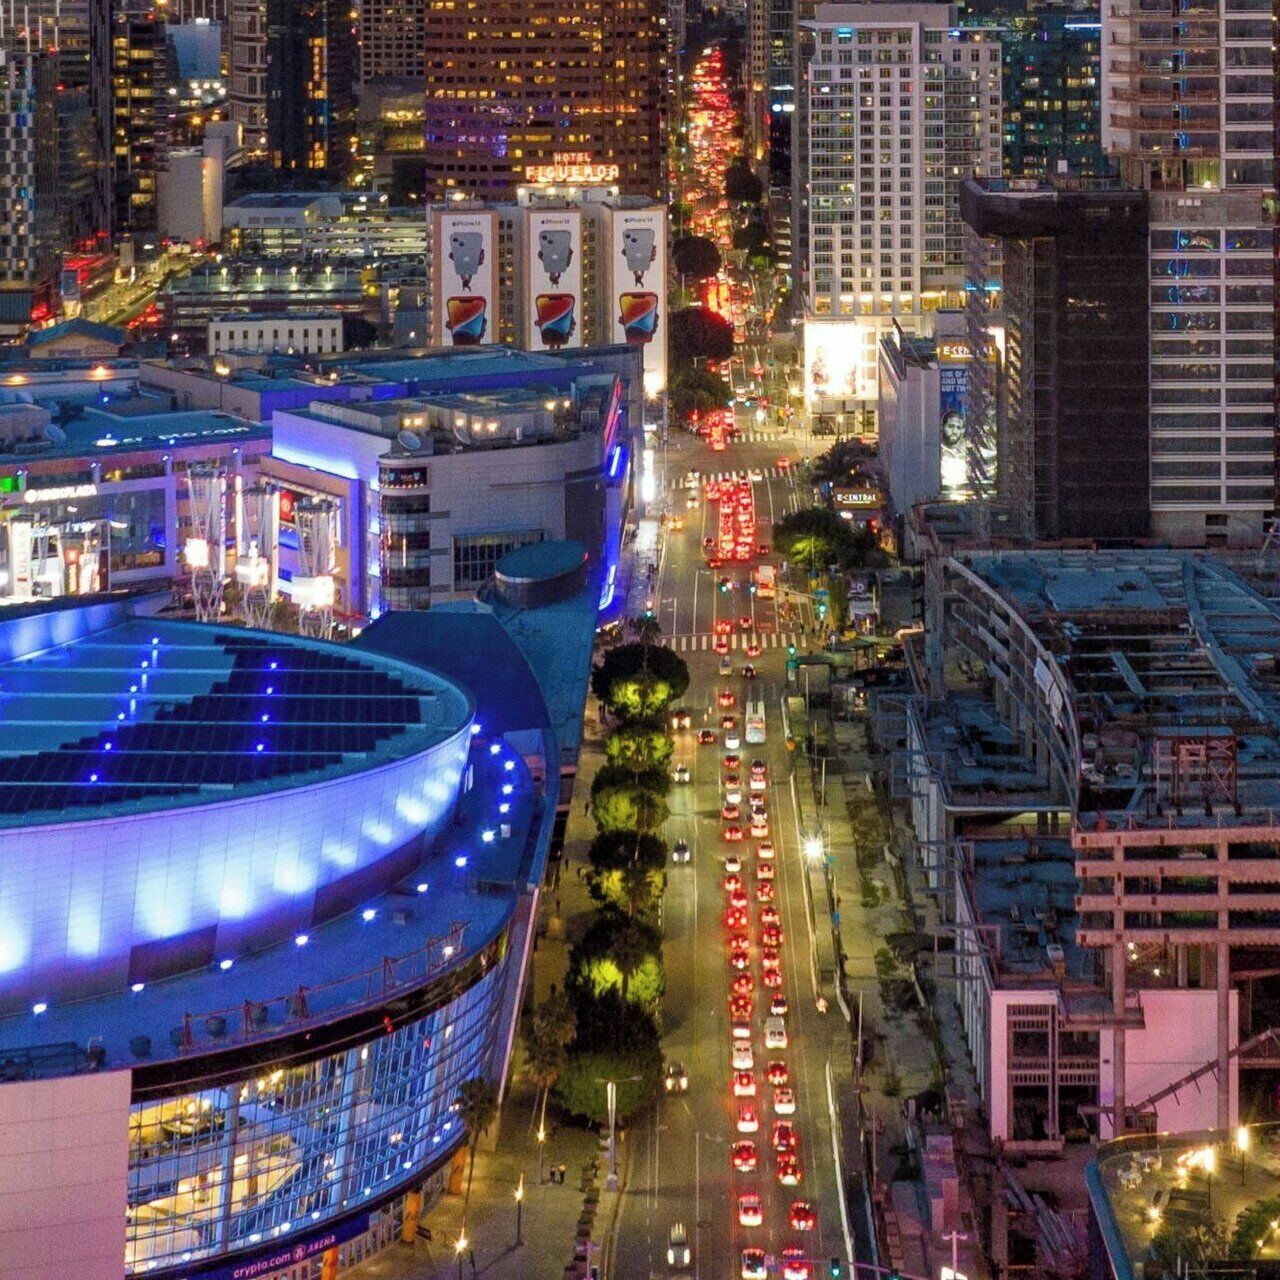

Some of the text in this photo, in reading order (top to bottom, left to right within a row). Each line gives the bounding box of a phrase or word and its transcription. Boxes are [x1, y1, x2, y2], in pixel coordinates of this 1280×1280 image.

[553, 152, 592, 162] HOTEL
[526, 165, 619, 181] FIGUEROA
[233, 1235, 336, 1278] crypto.com ARENA
